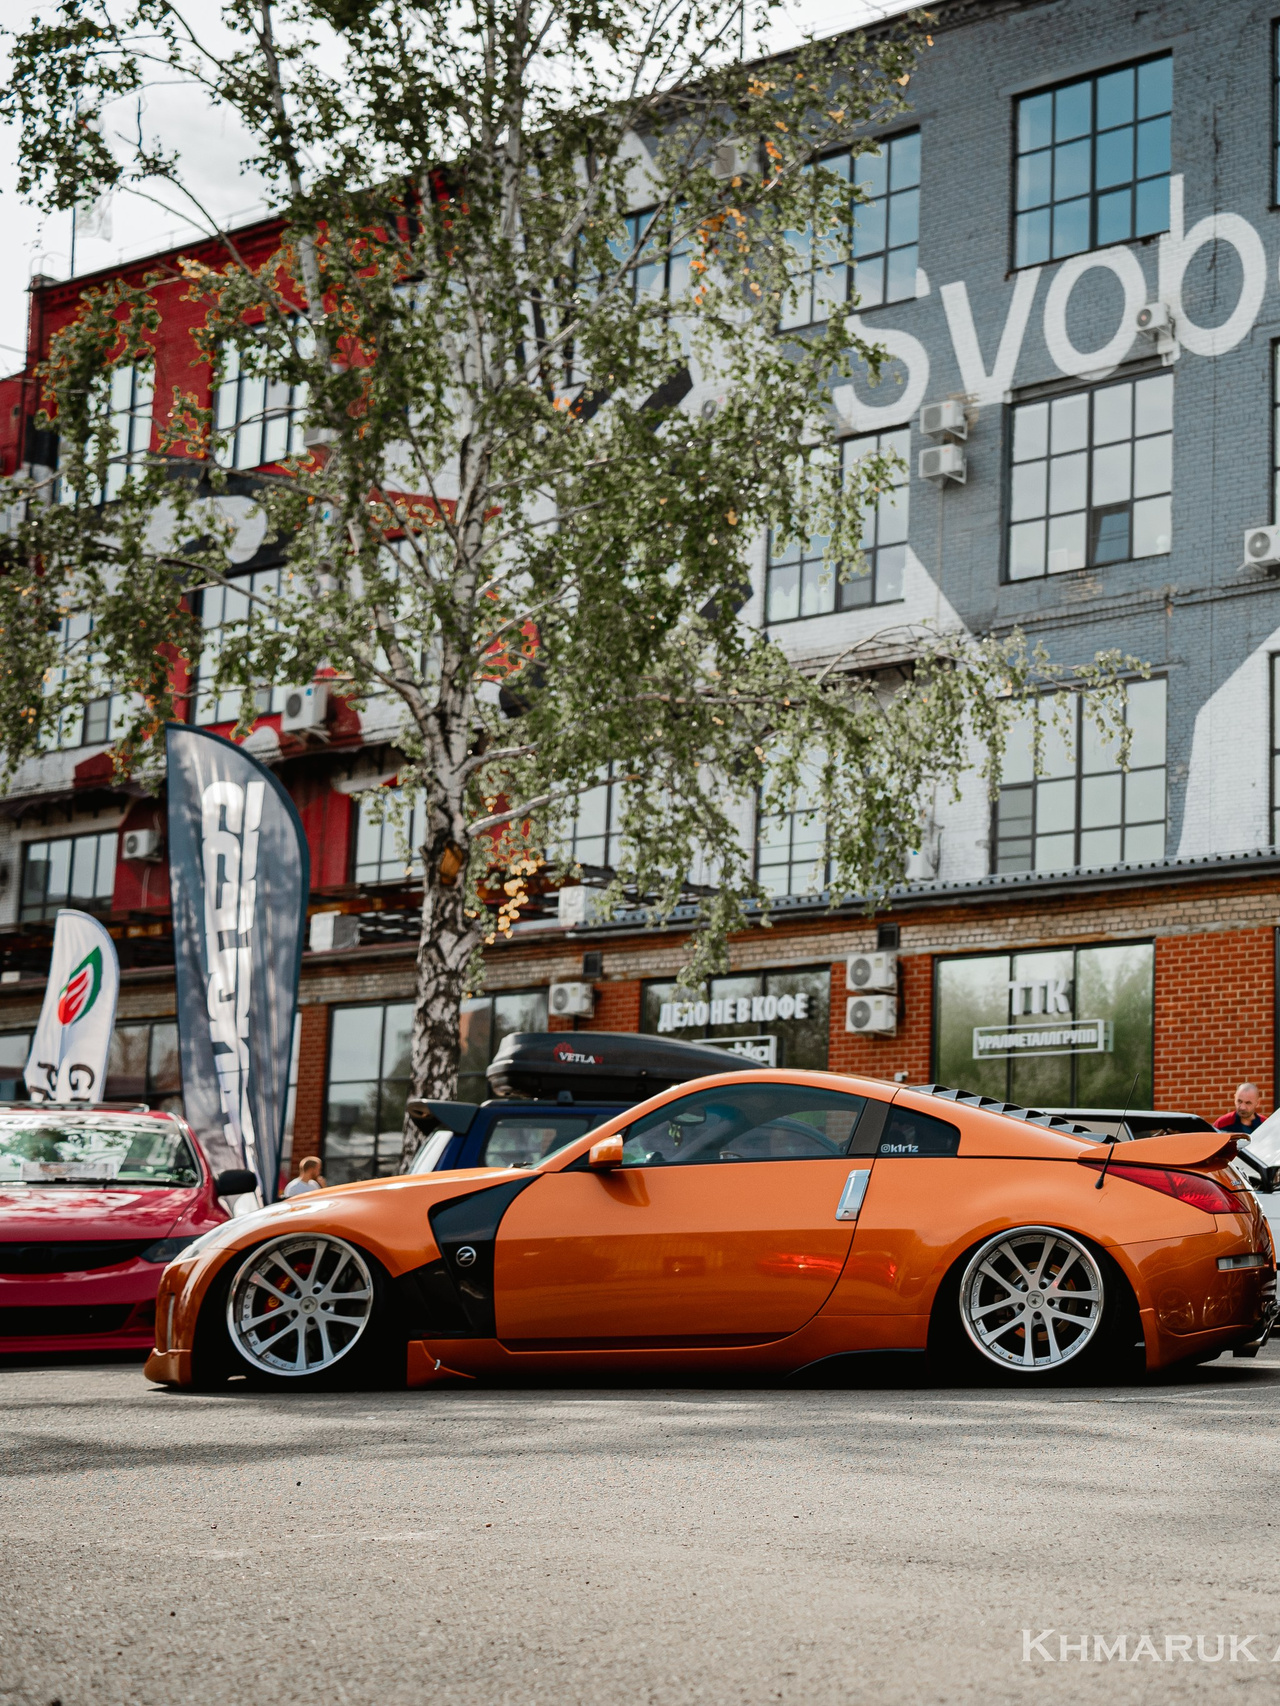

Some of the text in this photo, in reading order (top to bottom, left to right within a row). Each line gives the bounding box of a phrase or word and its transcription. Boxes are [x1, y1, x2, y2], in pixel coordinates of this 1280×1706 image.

[657, 992, 809, 1033] ДЕЛО НЕ В КОФЕ
